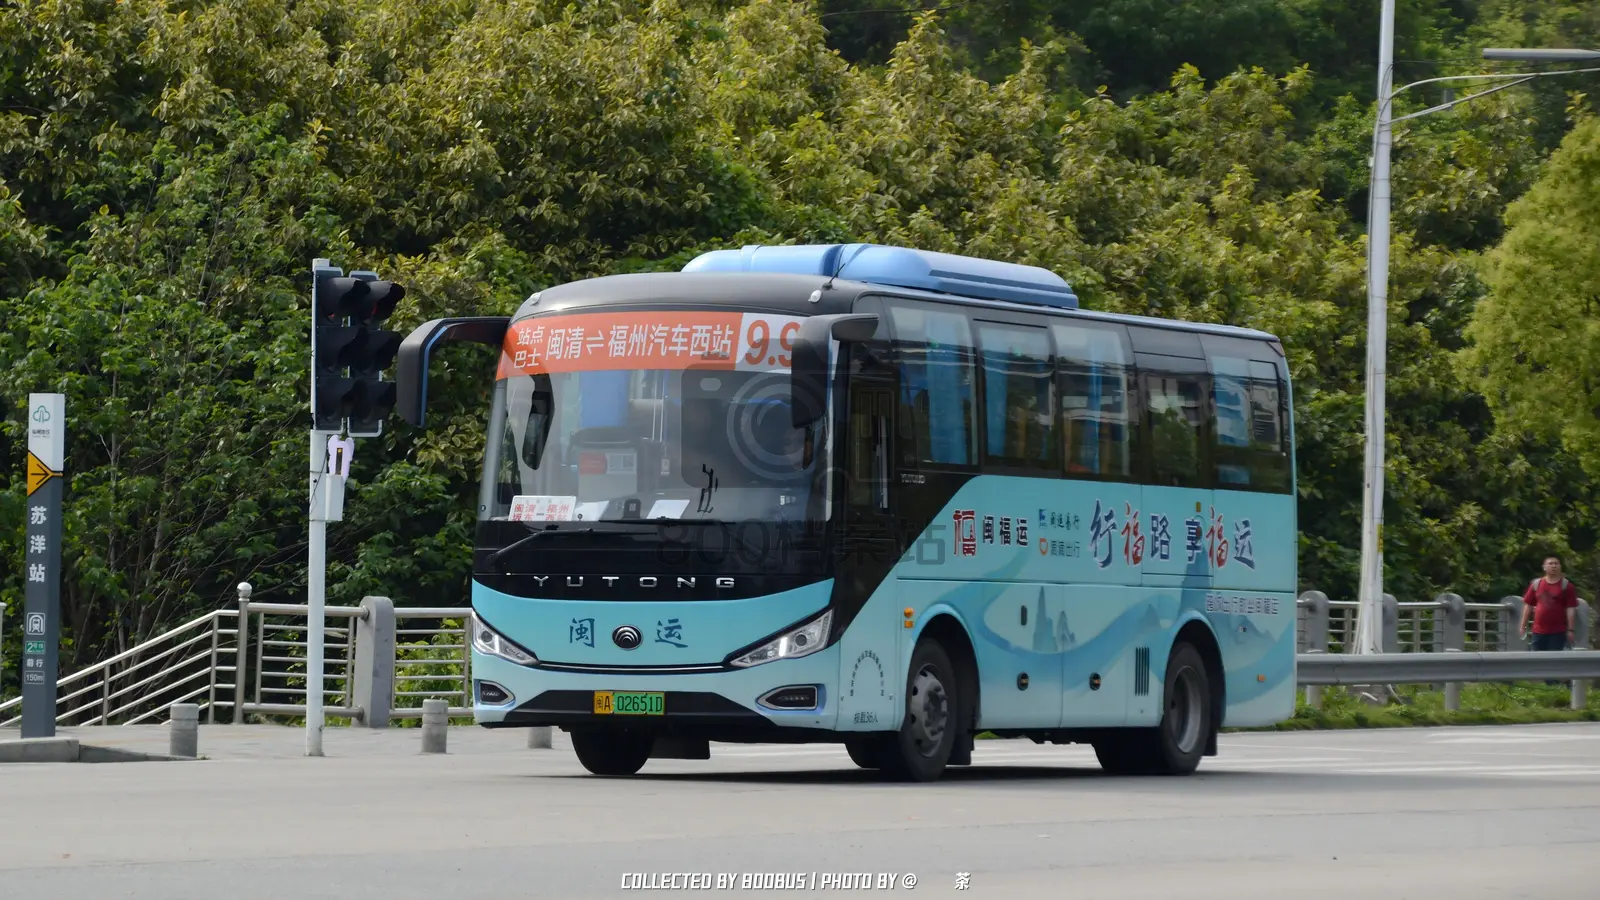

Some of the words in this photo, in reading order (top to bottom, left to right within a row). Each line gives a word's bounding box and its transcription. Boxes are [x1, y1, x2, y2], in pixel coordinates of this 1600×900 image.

[517, 325, 545, 346] 站点
[546, 326, 585, 361] 闽清
[608, 324, 734, 358] 福州汽车西站
[745, 319, 801, 368] 9.9
[513, 348, 541, 369] 巴士
[29, 505, 47, 582] 苏洋站
[982, 515, 1028, 547] 闽福运
[1090, 499, 1171, 569] 行福路
[533, 575, 735, 588] YUTONG
[26, 658, 44, 668] 前行
[26, 674, 43, 682] 150m
